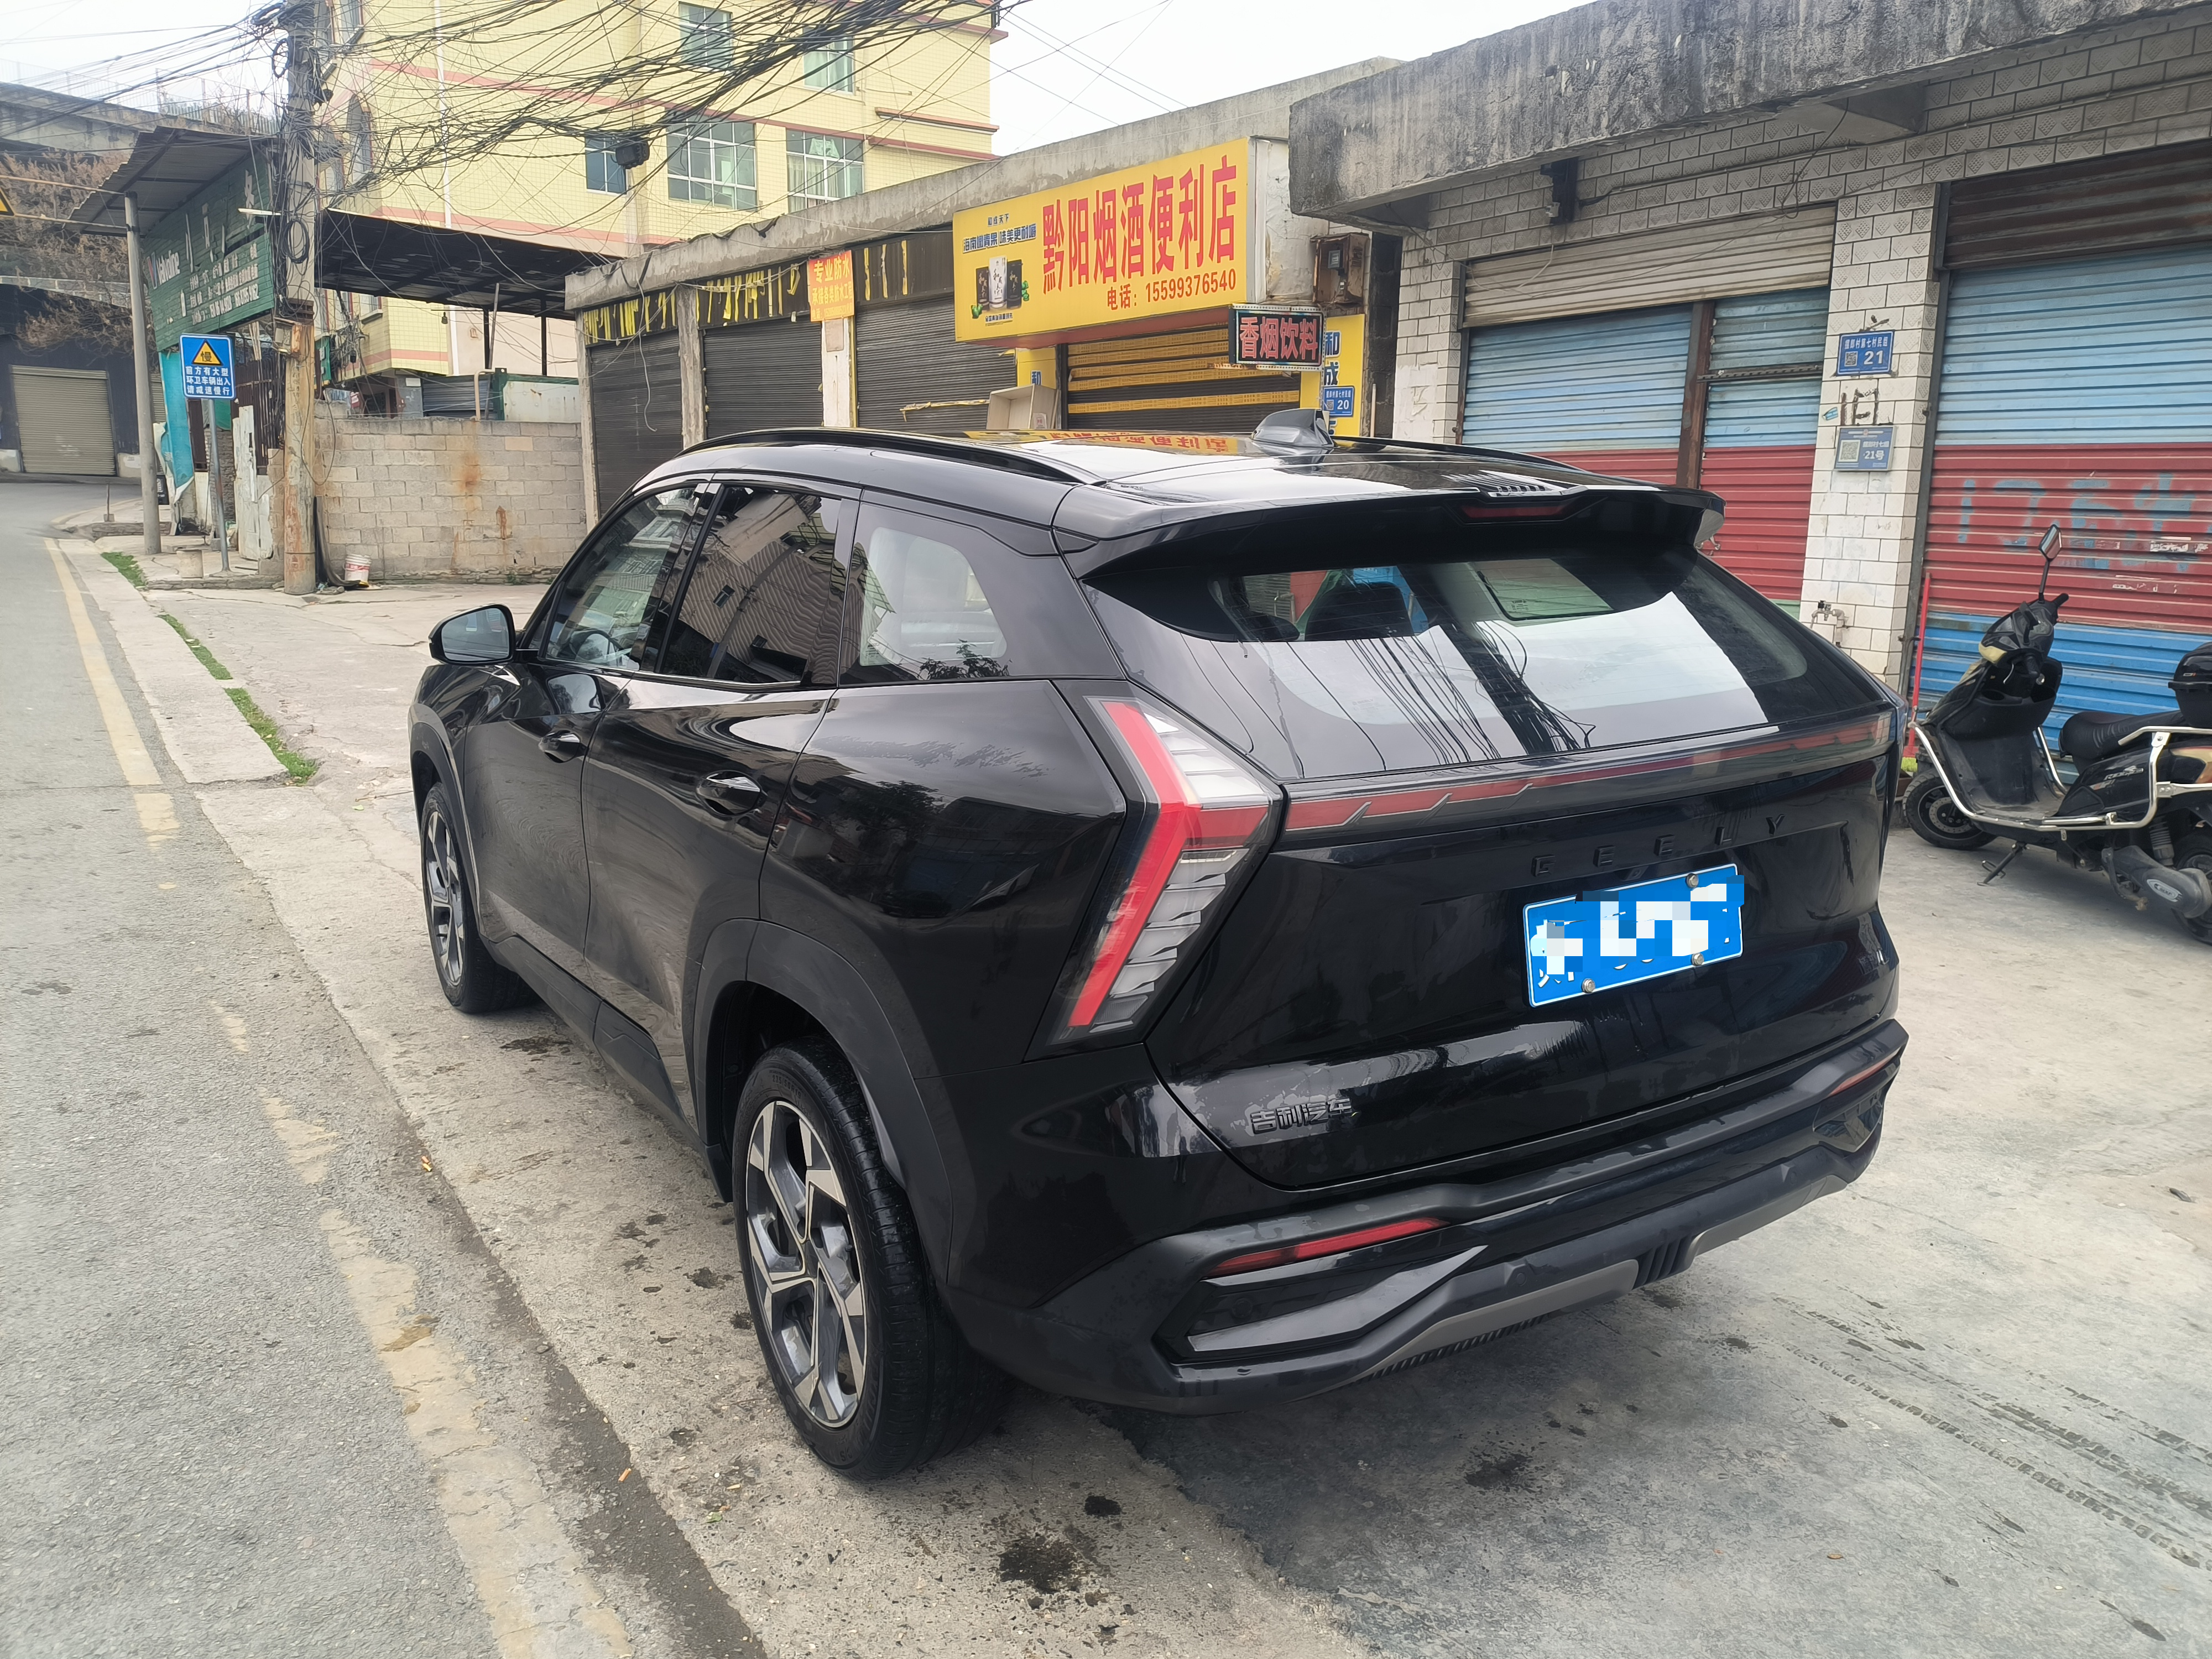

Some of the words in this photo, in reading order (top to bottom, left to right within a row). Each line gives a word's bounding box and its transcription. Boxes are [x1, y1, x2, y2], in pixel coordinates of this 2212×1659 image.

[1043, 154, 1237, 295] 黔阳烟酒便利店
[813, 253, 850, 284] 专业防水
[1239, 316, 1318, 360] 香烟饮料
[201, 351, 212, 362] 慢
[1863, 350, 1883, 365] 21
[185, 366, 229, 377] 前方有大型
[186, 375, 231, 386] 环卫车辆出入
[186, 385, 230, 396] 请减速慢行
[1337, 399, 1349, 410] 20
[1531, 813, 1786, 877] GEELY
[1250, 1098, 1353, 1134] 吉利汽车
